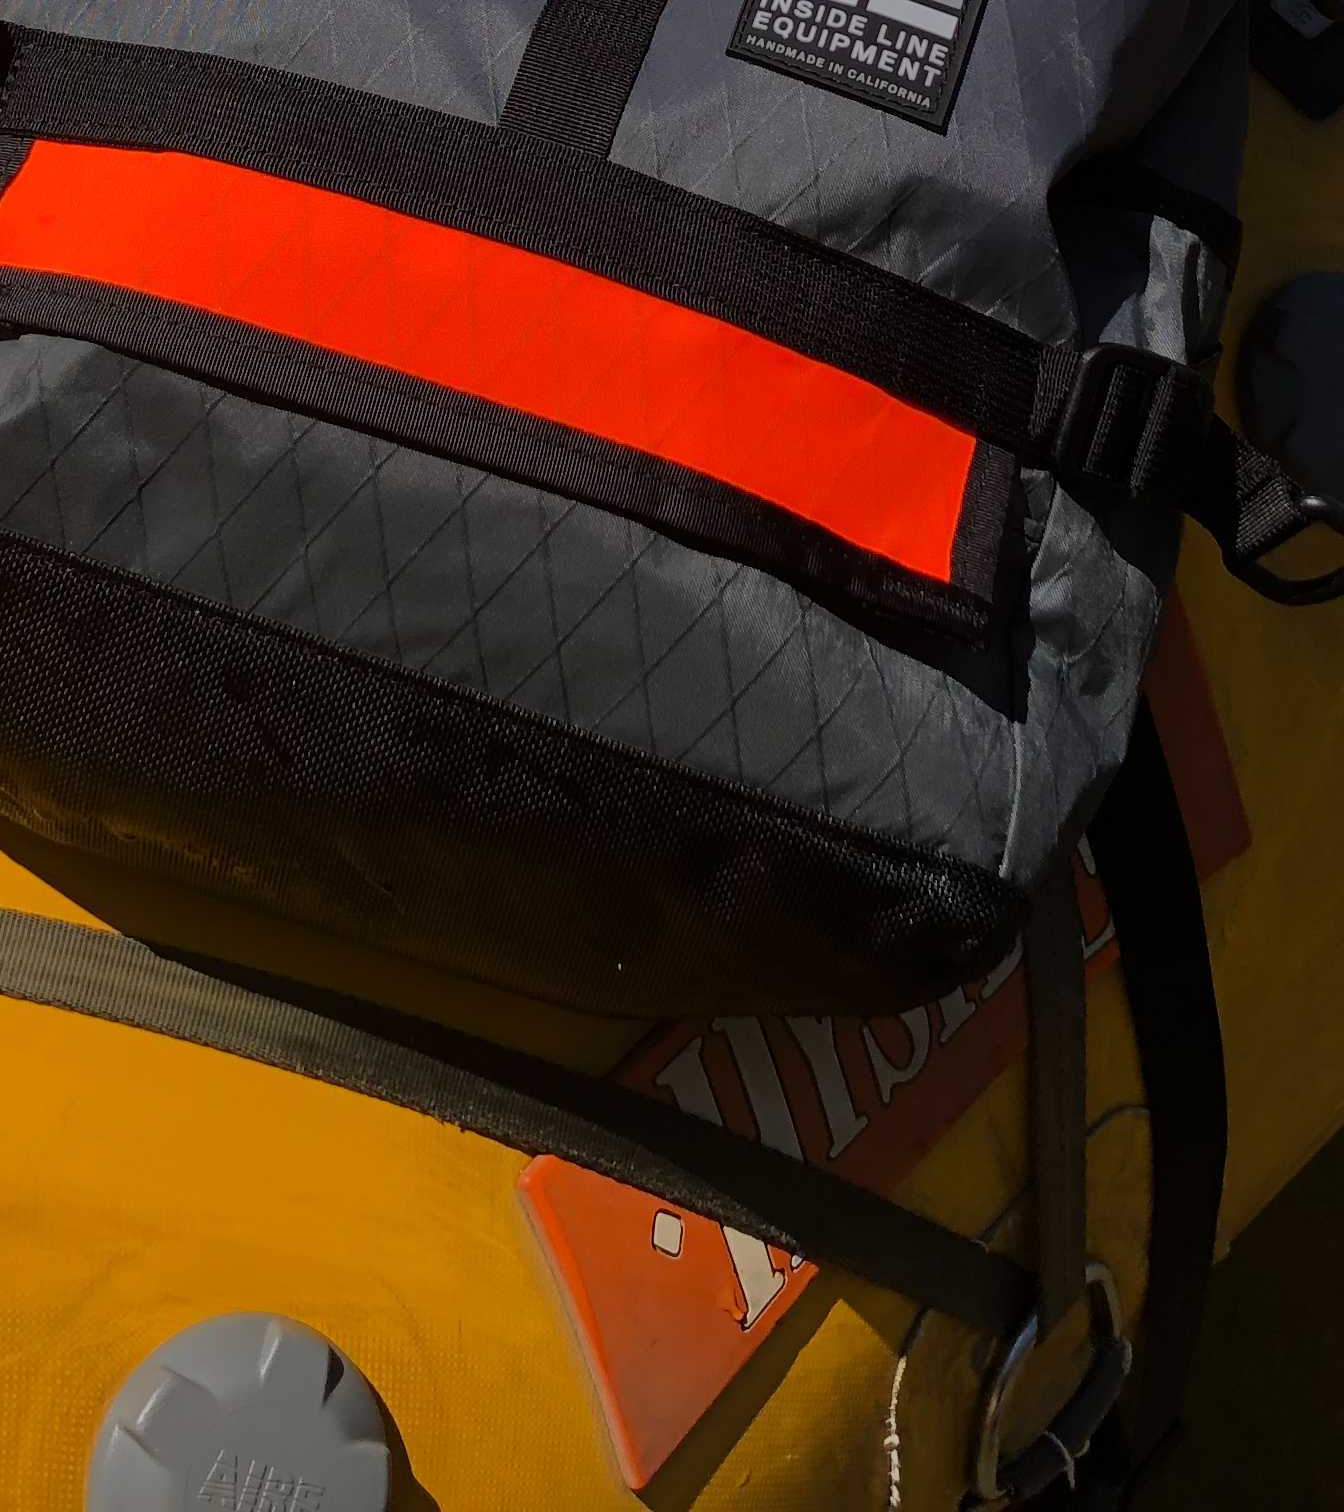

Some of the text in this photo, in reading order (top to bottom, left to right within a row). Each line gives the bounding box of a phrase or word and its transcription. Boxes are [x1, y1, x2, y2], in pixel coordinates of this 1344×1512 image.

[746, 35, 931, 108] HANDMADE IN CALIFORNIA
[752, 10, 942, 87] EQUIPMENT
[877, 24, 949, 66] LINE
